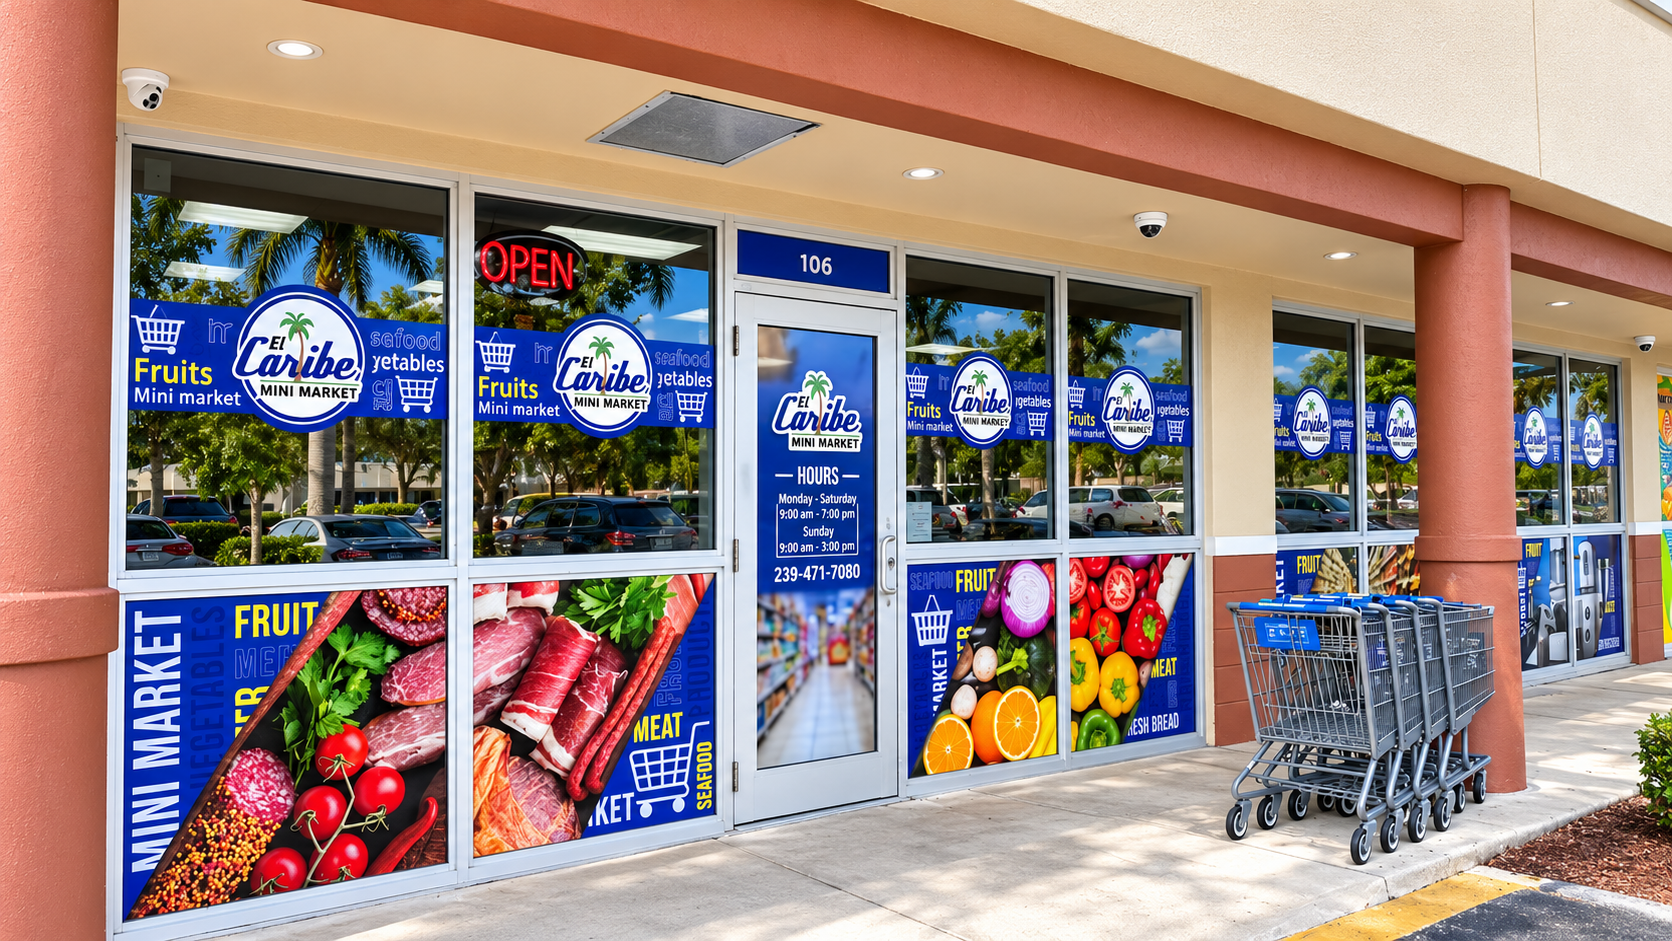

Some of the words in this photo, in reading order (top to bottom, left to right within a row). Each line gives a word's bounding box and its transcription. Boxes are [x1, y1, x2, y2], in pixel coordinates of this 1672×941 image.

[480, 240, 574, 290] OPEN
[800, 254, 833, 276] 106
[235, 336, 358, 380] Caribe
[134, 358, 213, 386] Fruits
[555, 357, 647, 393] Caribe
[134, 387, 174, 405] Mini
[179, 390, 242, 407] market
[260, 384, 294, 397] MINI
[299, 386, 358, 399] MARKET
[478, 375, 539, 400] Fruits
[478, 400, 509, 415] Mini
[513, 402, 560, 418] market
[574, 396, 600, 408] MINI
[603, 398, 648, 410] MARKET
[907, 401, 942, 418] Fruits
[951, 385, 1010, 414] Caribe
[1103, 396, 1152, 422] Caribe
[775, 396, 860, 432] Caribe
[1068, 411, 1096, 427] Fruits
[907, 420, 924, 431] Mini
[926, 421, 954, 433] market
[791, 437, 815, 448] MINI
[818, 438, 860, 449] MARKET
[797, 466, 839, 485] HOURS
[779, 493, 813, 507] Monday
[820, 493, 857, 506] Saturday
[779, 509, 799, 520] 9:00
[800, 510, 814, 519] am
[821, 508, 840, 519] 7:00
[842, 510, 855, 521] pm
[803, 525, 834, 539] Sunday
[779, 542, 799, 553] 9:00
[800, 543, 814, 553] am
[821, 541, 840, 552] 3:00
[842, 543, 855, 553] pm
[774, 563, 860, 583] 239-471-7080
[1296, 554, 1322, 574] FRUIT
[956, 568, 997, 593] FRUIT
[235, 601, 319, 639] FRUIT
[1151, 657, 1178, 679] MEAT
[133, 610, 182, 770] MARKET
[633, 711, 684, 743] MEAT
[1152, 712, 1180, 733] BREAD
[696, 740, 713, 811] SEAFOOD
[131, 781, 180, 873] MINI
